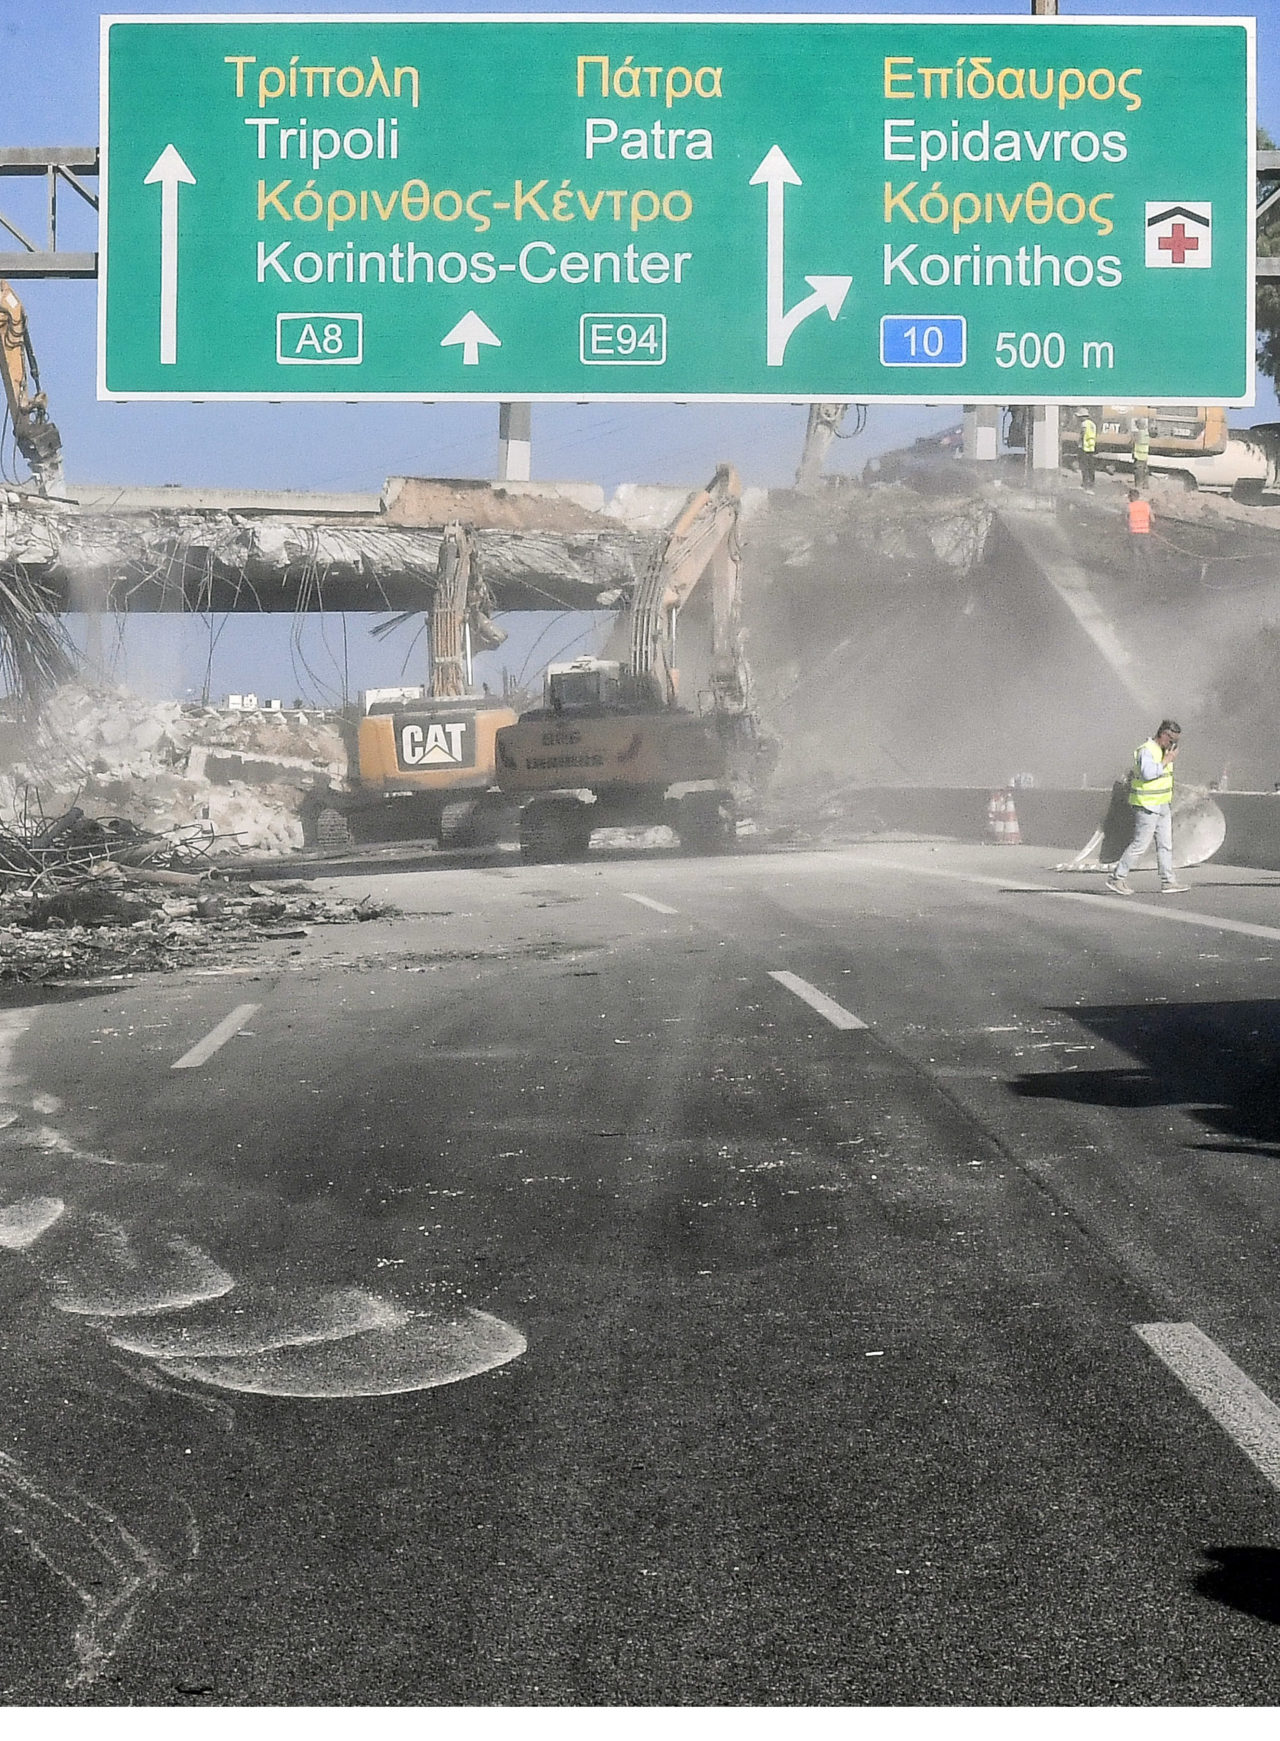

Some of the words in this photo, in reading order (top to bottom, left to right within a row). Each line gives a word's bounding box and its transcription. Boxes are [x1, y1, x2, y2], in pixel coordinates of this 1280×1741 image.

[224, 56, 420, 108] Τρίπολη
[576, 55, 723, 107] Πάτρα
[883, 57, 1143, 111] Επίδαυρος
[245, 118, 399, 170] Tripoli
[585, 118, 715, 161] Patra
[883, 119, 1128, 171] Epidavros
[257, 179, 693, 232] Κόρινθος-Κέντρο
[883, 181, 1115, 235] Κόρινθος
[257, 241, 693, 285] Korinthos-Center
[883, 244, 1123, 288] Korinthos
[294, 324, 343, 355] A8
[590, 324, 658, 356] E94
[903, 326, 944, 357] 10
[995, 332, 1066, 368] 500
[1082, 341, 1114, 368] m
[1103, 423, 1120, 433] CAT
[402, 723, 466, 765] CAT
